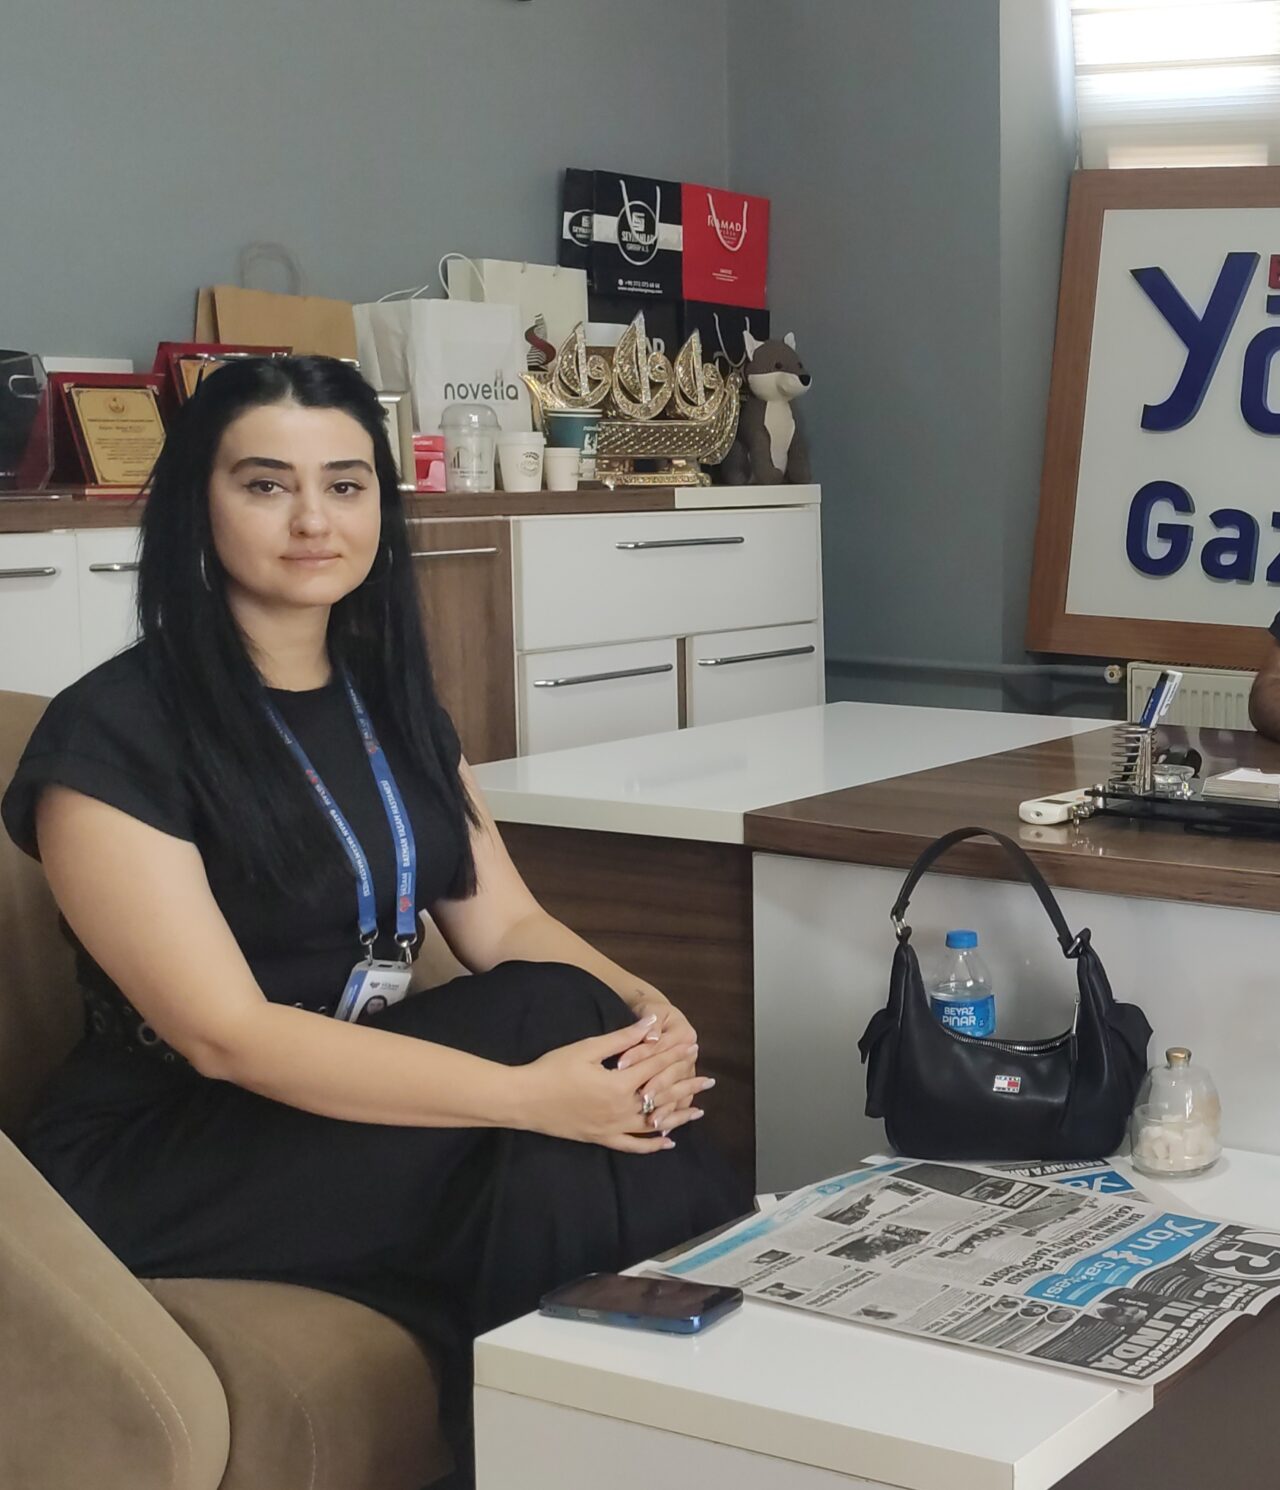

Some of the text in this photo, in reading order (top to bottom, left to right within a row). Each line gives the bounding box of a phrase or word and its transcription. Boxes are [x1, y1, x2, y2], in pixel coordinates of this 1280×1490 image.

[707, 215, 747, 234] RMAD
[399, 837, 410, 868] BATMAN
[942, 1015, 977, 1027] PINAR
[944, 1006, 975, 1016] BEYAZ
[1127, 1219, 1210, 1250] Yön
[1086, 1297, 1202, 1372] ILINDA
